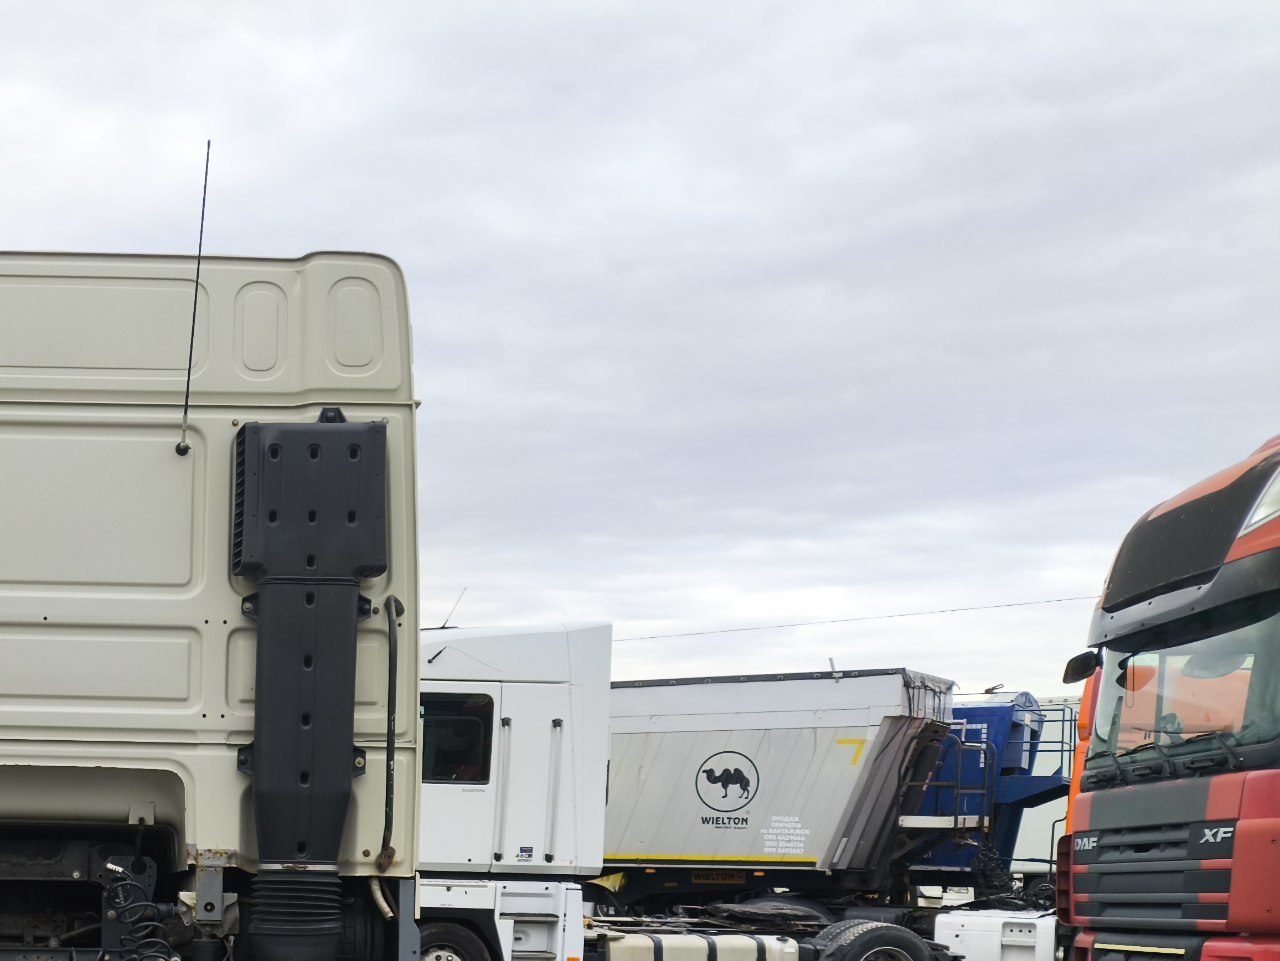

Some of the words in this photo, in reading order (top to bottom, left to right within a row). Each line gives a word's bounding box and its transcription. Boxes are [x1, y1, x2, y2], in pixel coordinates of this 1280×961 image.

[701, 816, 749, 826] WIELTON
[1074, 837, 1098, 851] DAF
[1199, 827, 1234, 844] XF
